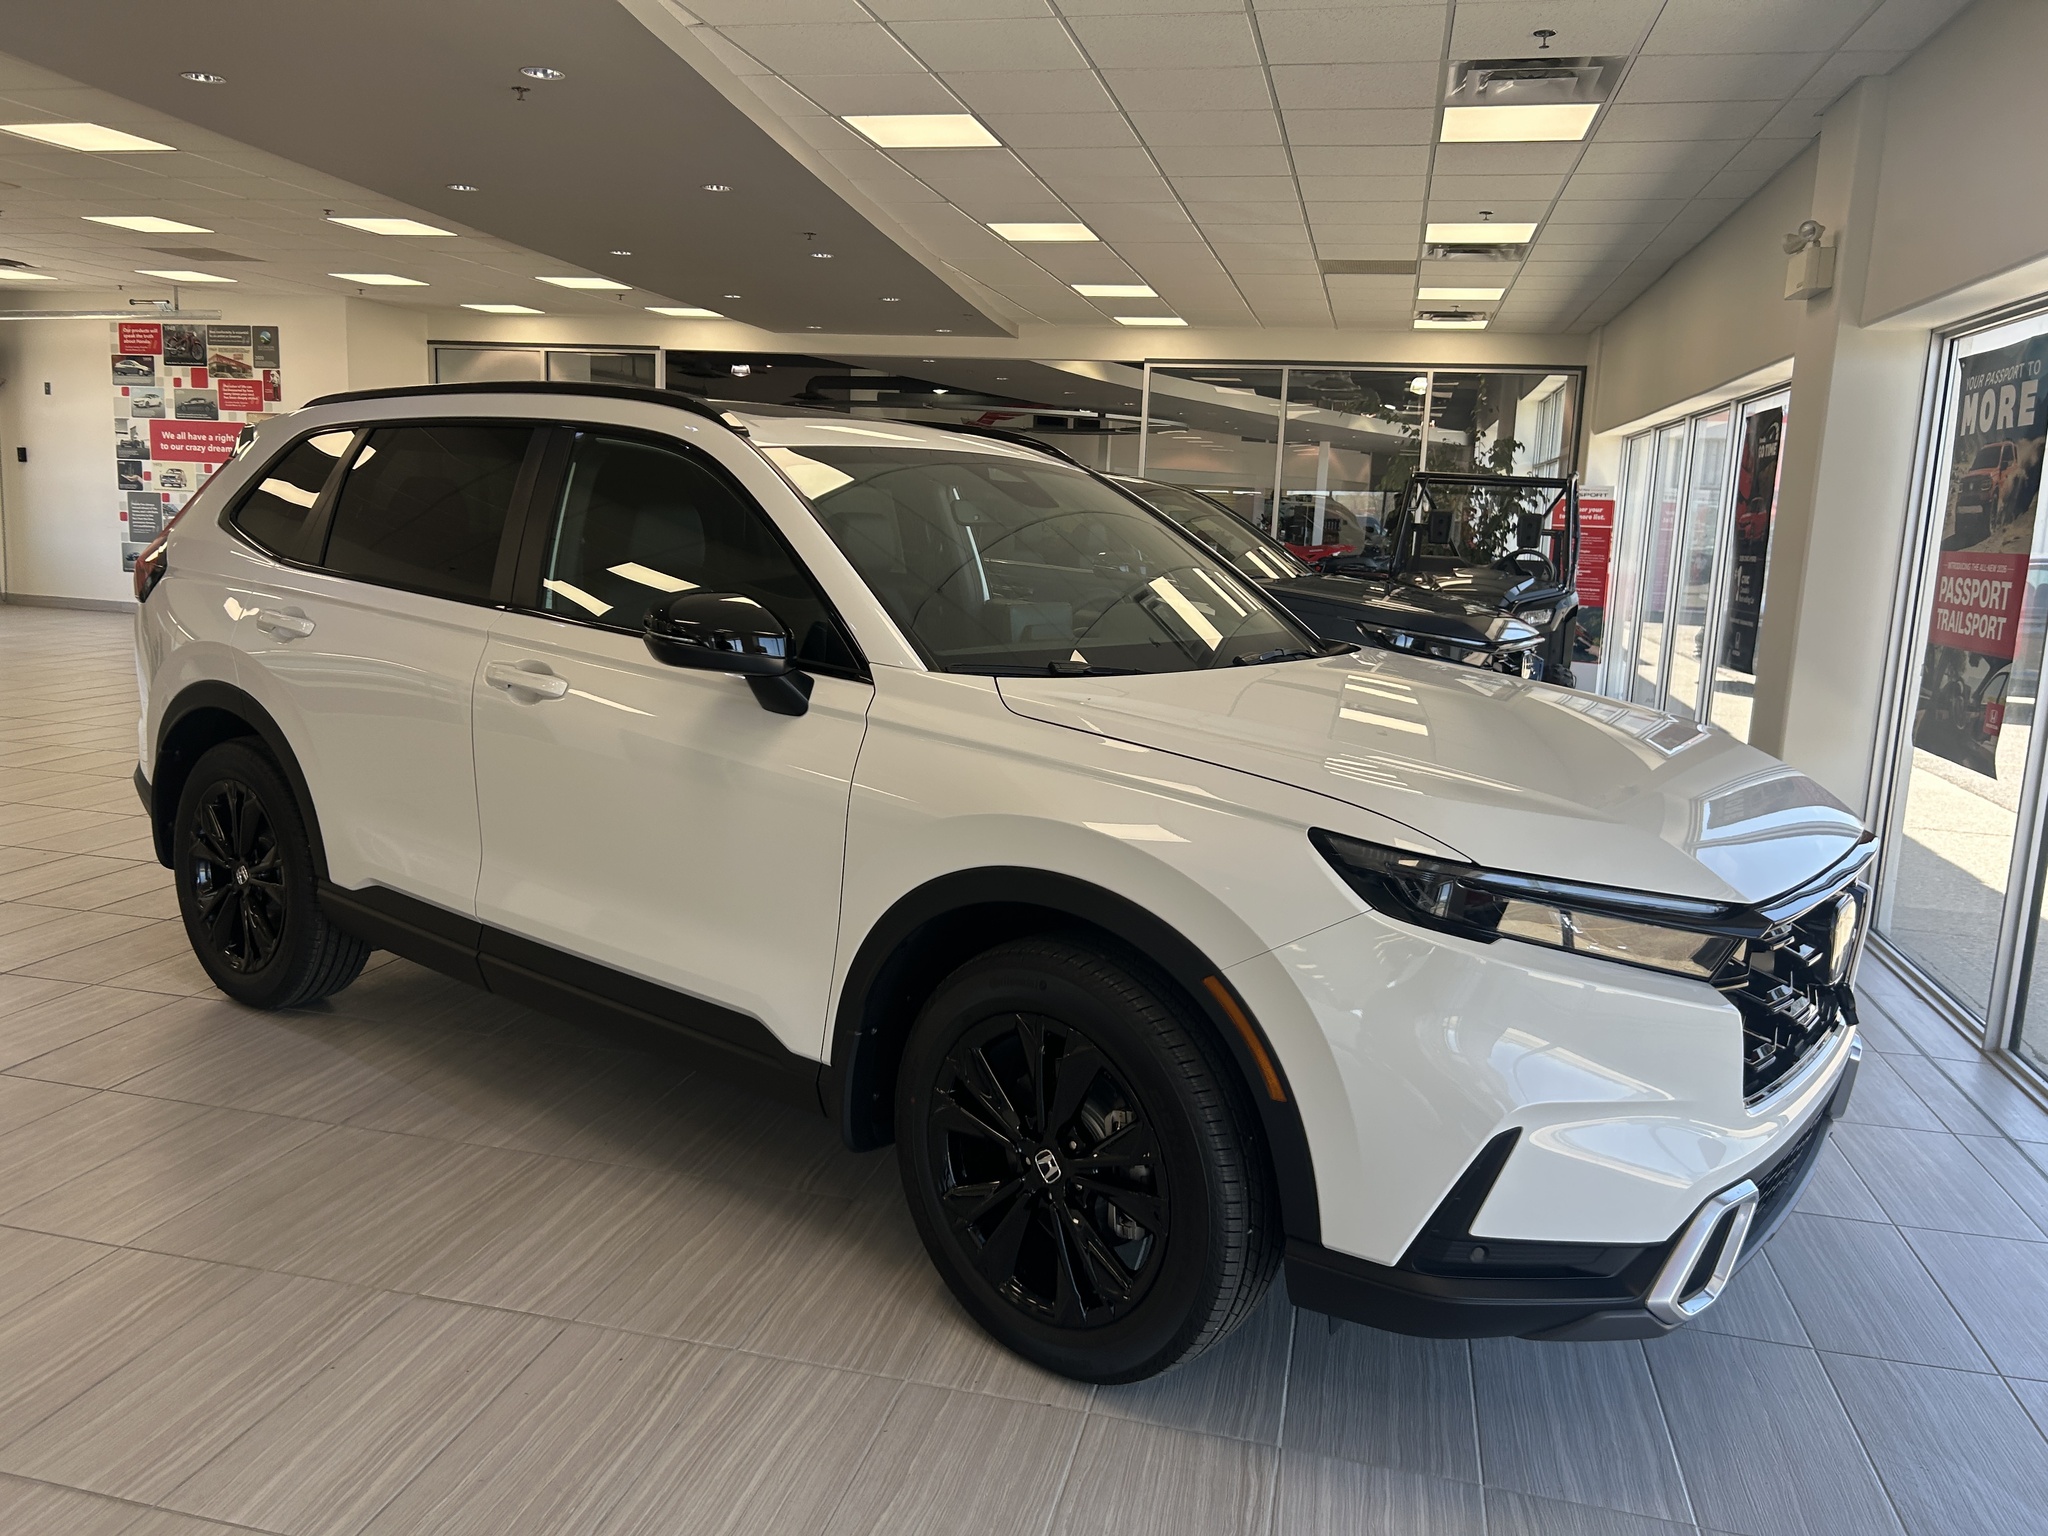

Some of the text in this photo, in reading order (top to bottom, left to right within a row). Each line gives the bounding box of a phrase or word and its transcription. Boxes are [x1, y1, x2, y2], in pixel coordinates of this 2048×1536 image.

[1966, 359, 2041, 391] YOUR PASSPORT TO
[1960, 379, 2039, 436] MORE
[161, 431, 175, 439] We
[176, 432, 186, 440] all
[187, 432, 207, 440] have
[215, 433, 235, 443] right
[185, 445, 206, 453] crazy
[207, 443, 233, 452] dream
[1939, 576, 2013, 611] PASSPORT
[1936, 608, 2007, 641] TRAILSPORT
